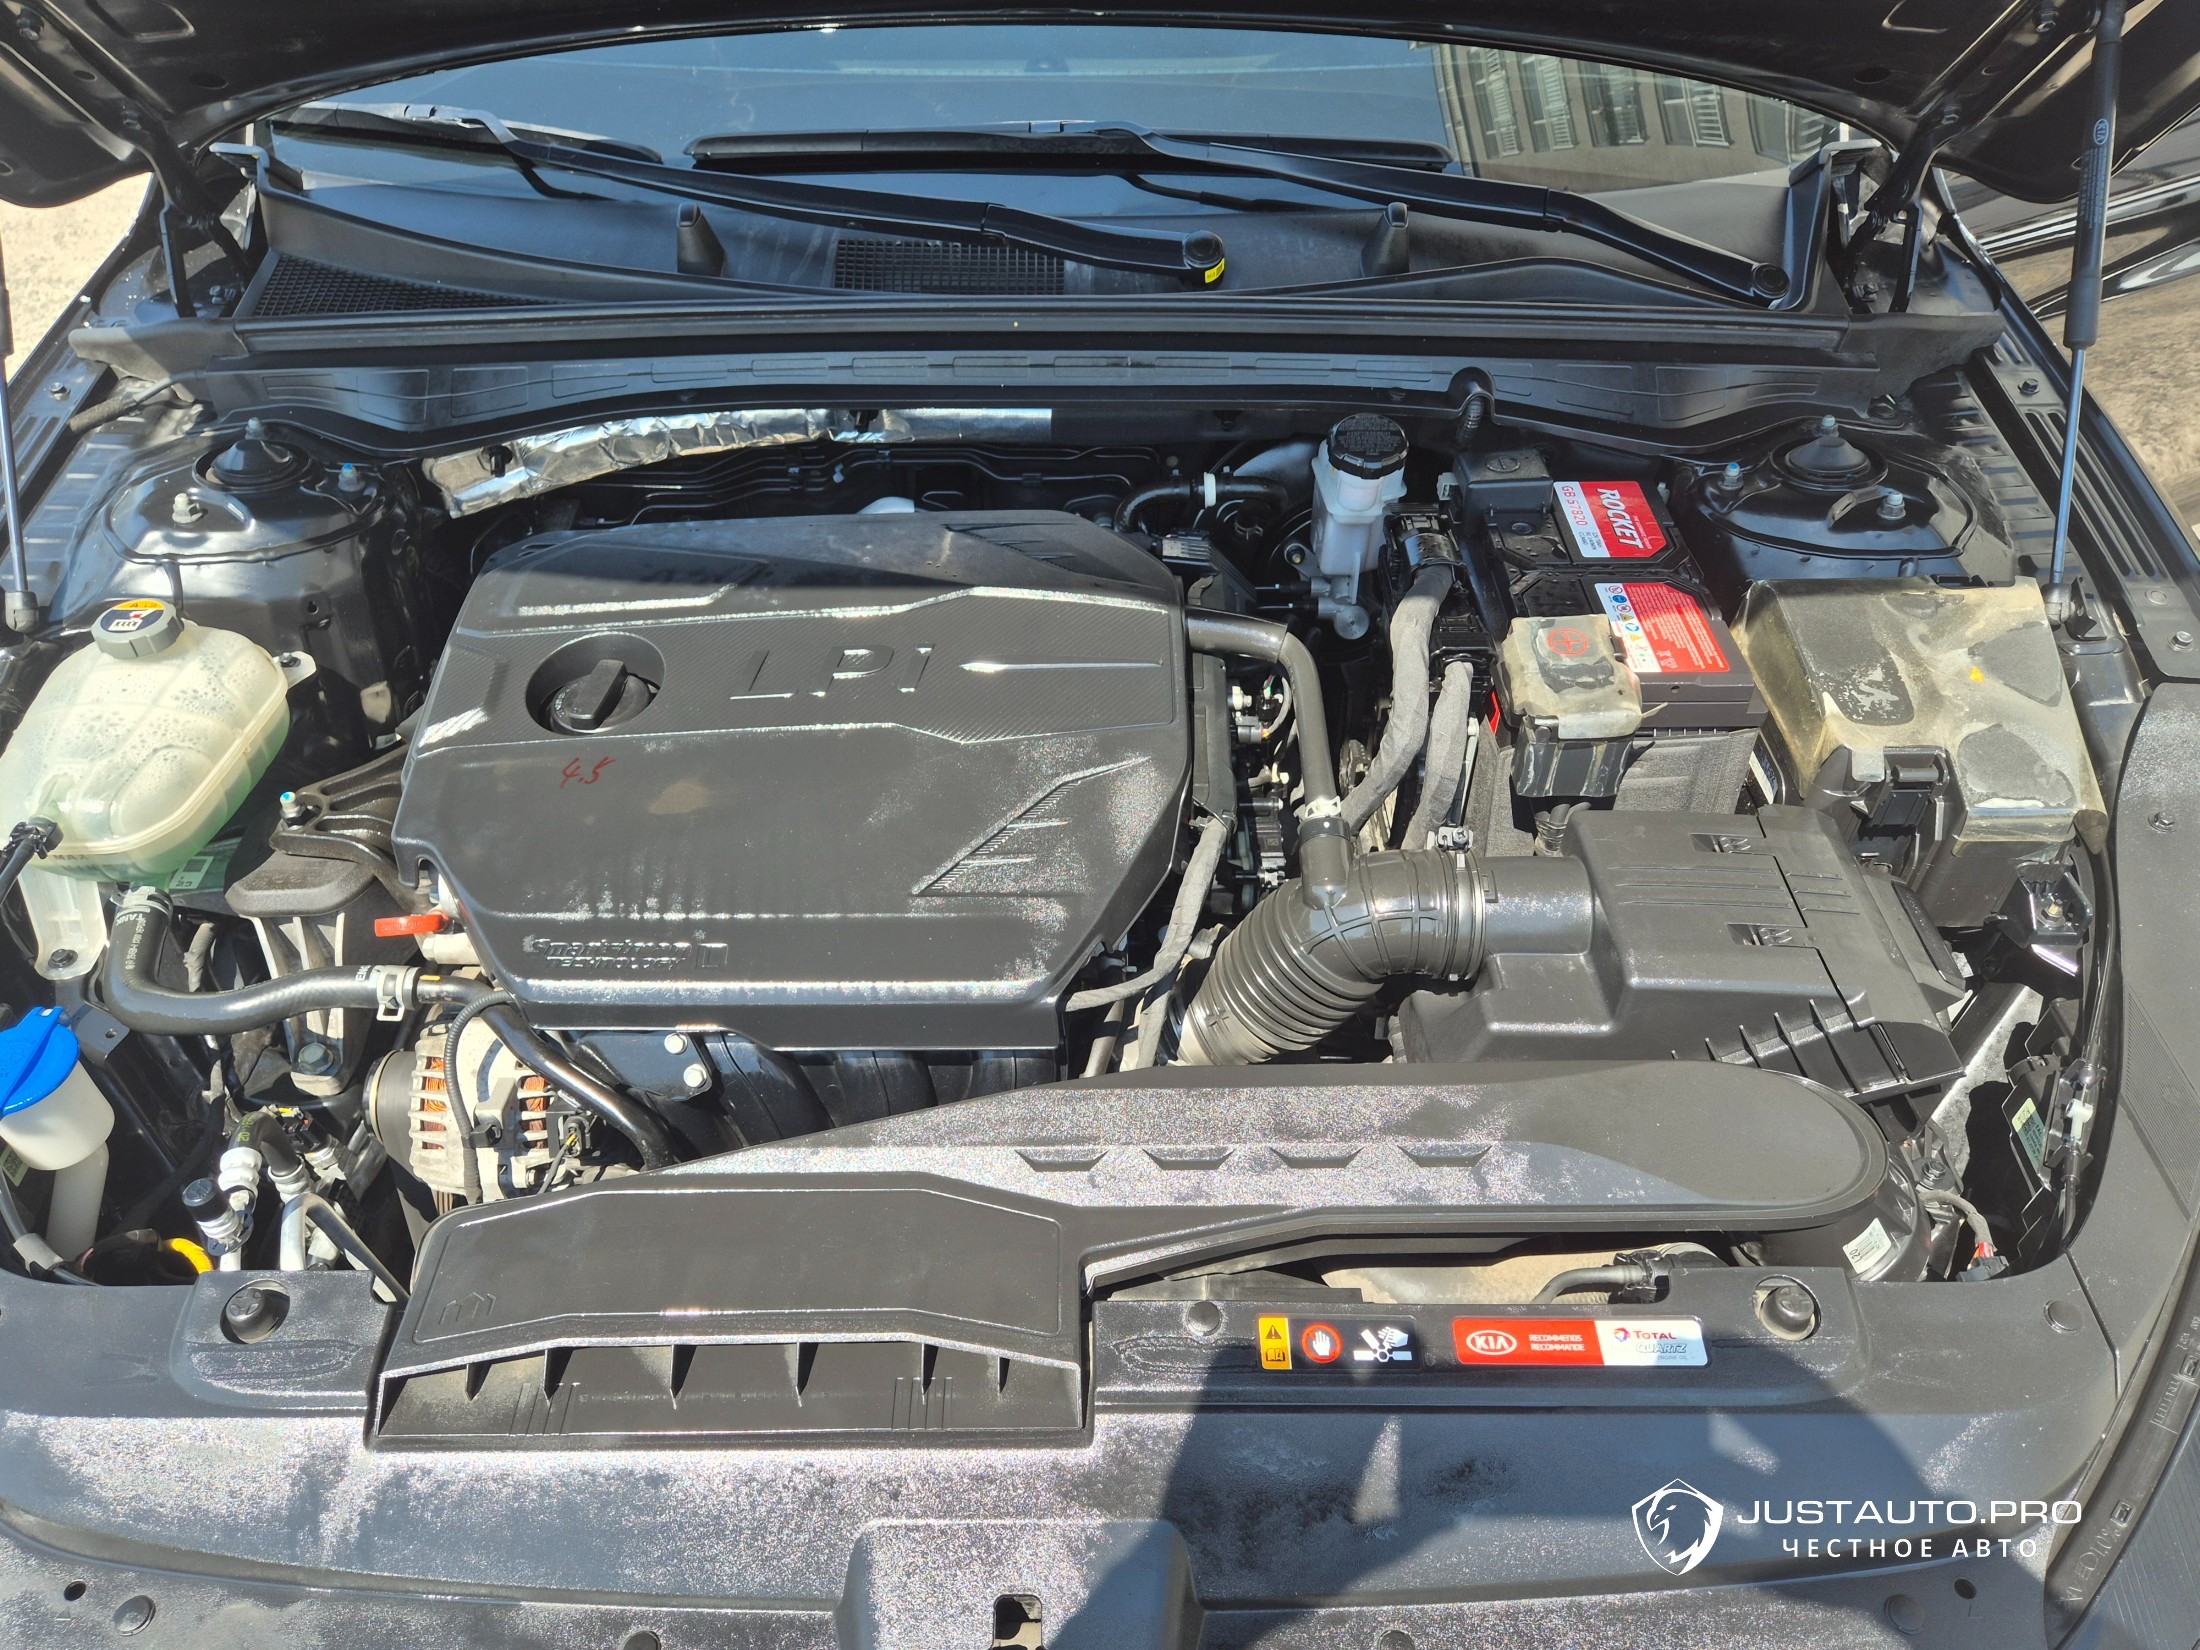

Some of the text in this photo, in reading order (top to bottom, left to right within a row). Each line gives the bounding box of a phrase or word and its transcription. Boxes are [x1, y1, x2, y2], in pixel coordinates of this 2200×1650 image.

[2096, 122, 2107, 141] KIA
[1562, 486, 1588, 526] GB 57820
[1597, 488, 1644, 549] ROCKET
[1475, 1335, 1510, 1350] KIA
[1529, 1334, 1583, 1342] RECOMMENDS
[1530, 1343, 1585, 1351] RECOMMANDE
[1636, 1342, 1687, 1353] QUARTZ
